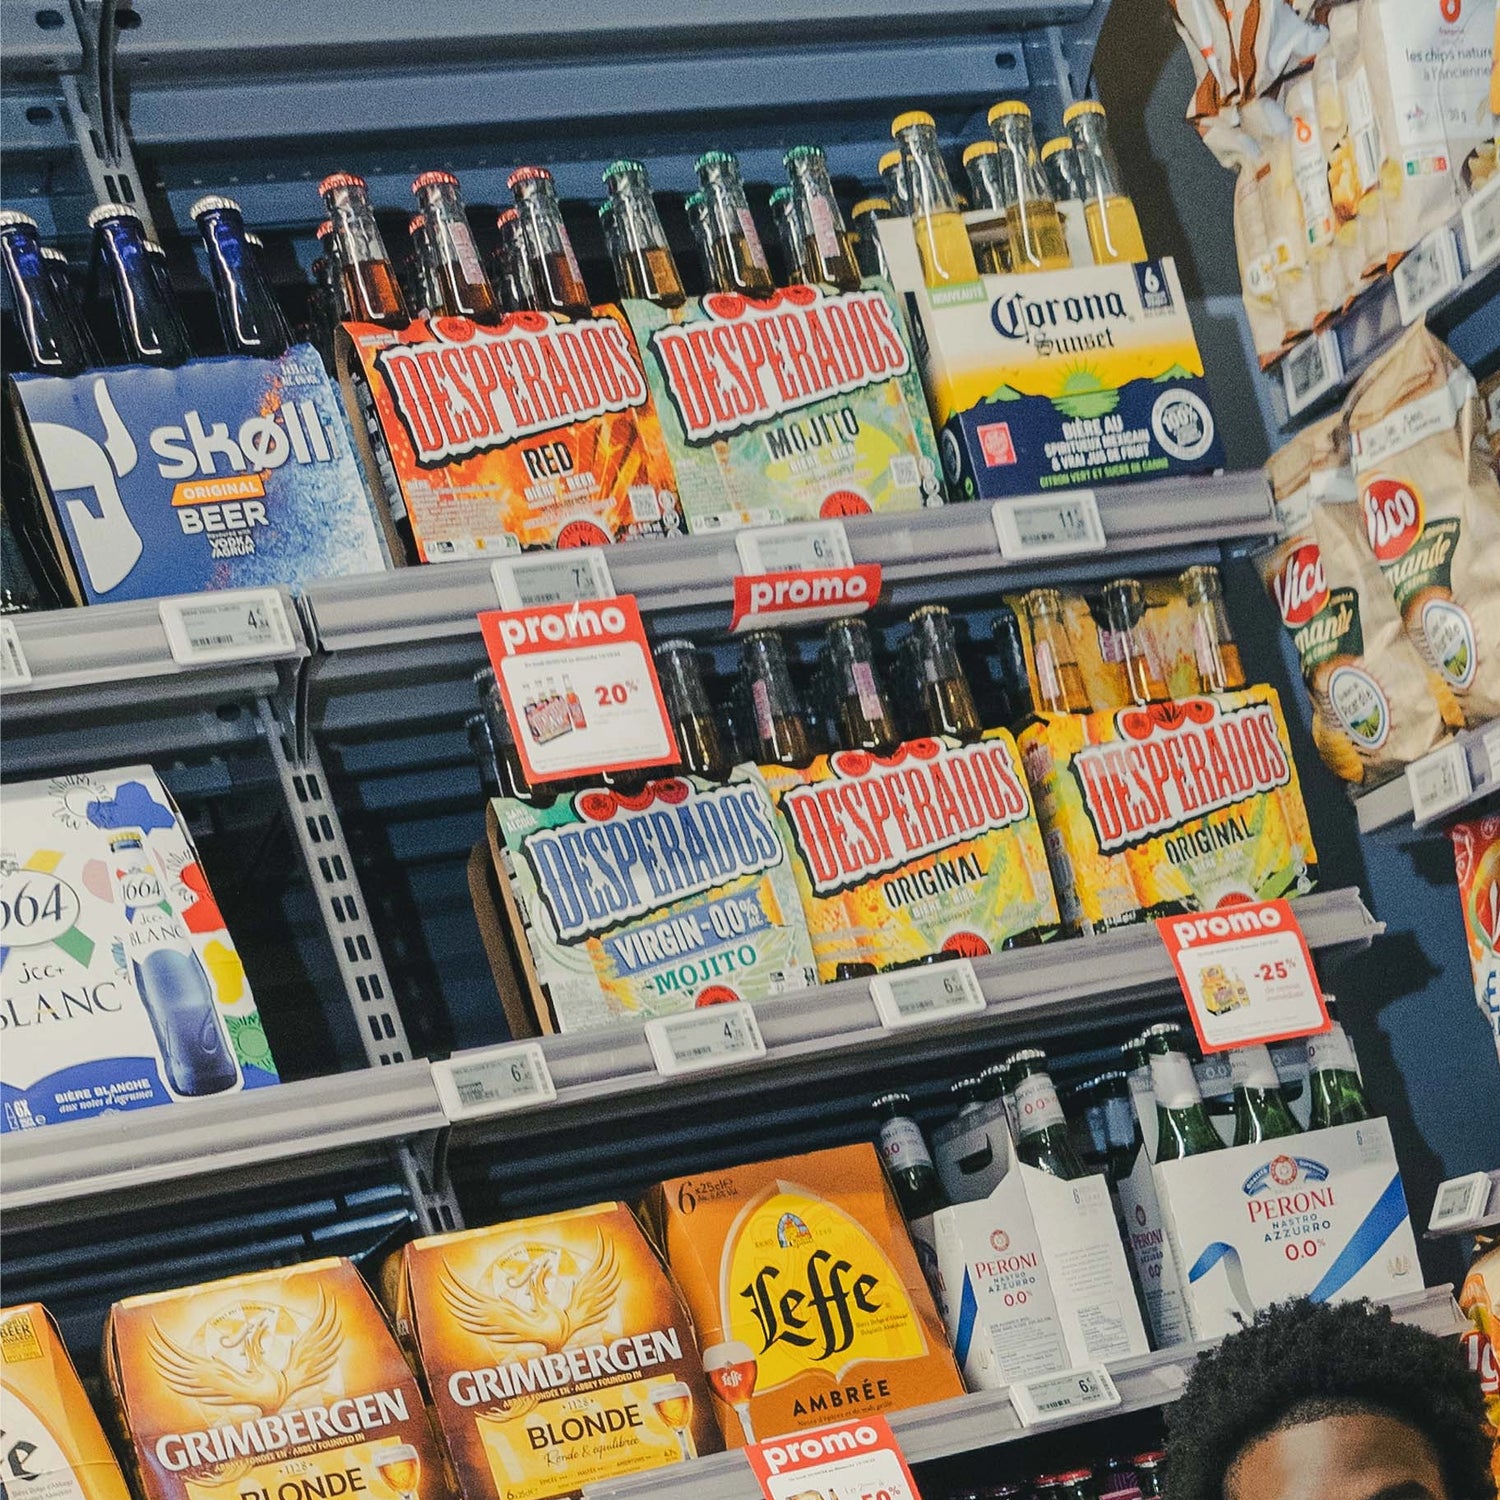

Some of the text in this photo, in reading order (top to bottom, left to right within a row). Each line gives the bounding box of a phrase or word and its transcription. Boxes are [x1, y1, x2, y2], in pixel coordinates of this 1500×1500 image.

[1425, 47, 1453, 63] chips
[1144, 267, 1159, 293] 6
[991, 289, 1127, 343] Corona
[660, 297, 904, 430] DESPERADOS
[1034, 327, 1115, 356] Sunset
[388, 327, 641, 452] DESPERADOS
[150, 401, 332, 479] skøll
[766, 407, 859, 460] MOJITO
[522, 442, 574, 479] RED
[183, 481, 259, 500] ORIGINAL
[178, 502, 269, 535] BEER
[751, 575, 867, 613] promo
[499, 606, 625, 654] promo
[1080, 714, 1286, 841] DESPERADOS
[790, 747, 1024, 882] DESPERADOS
[529, 790, 777, 929] DESPERADOS
[1165, 814, 1253, 865] ORIGINAL
[883, 852, 988, 910] ORIGINAL
[614, 915, 704, 969] VIRGIN
[1173, 907, 1281, 947] promo
[653, 945, 757, 996] MOJITO
[1247, 1187, 1334, 1223] PERONI
[1272, 1213, 1318, 1229] NASTRO
[1264, 1220, 1331, 1242] AZZURRO
[975, 1252, 1038, 1279] PERONI
[740, 1250, 882, 1362] Leffe
[449, 1328, 683, 1407] GRIMBERGEN
[793, 1379, 890, 1416] AMBRÉE
[156, 1389, 410, 1472] GRIMBERGEN
[527, 1404, 644, 1450] BLONDE
[762, 1427, 878, 1474] promo
